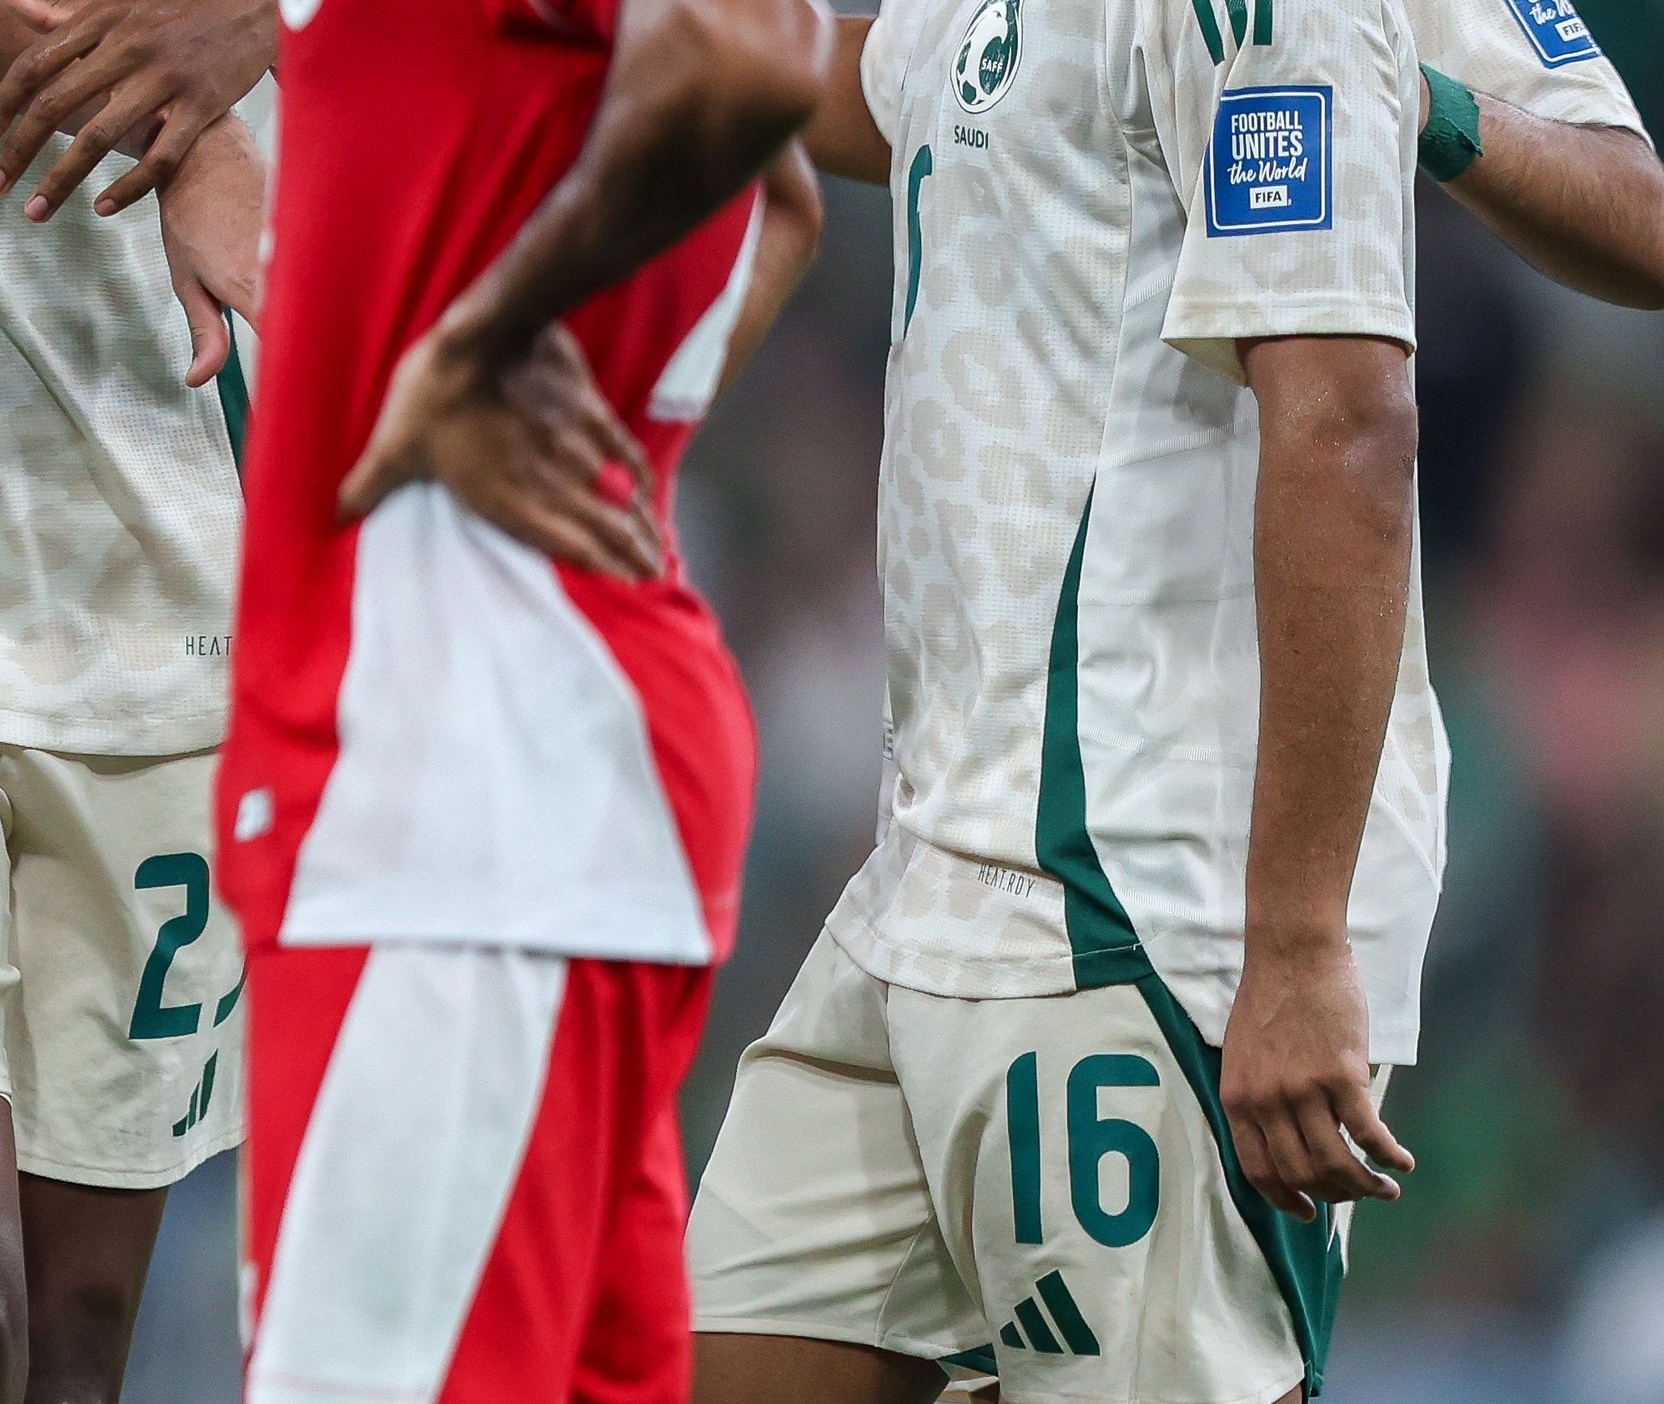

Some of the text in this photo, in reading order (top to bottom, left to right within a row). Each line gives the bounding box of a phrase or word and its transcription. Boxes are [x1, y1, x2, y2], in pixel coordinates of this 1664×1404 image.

[980, 58, 1005, 74] SAFF
[1231, 110, 1303, 133] FOOTBALL
[954, 124, 990, 150] SAUDI
[1231, 130, 1304, 161] UNITES
[1226, 156, 1308, 185] the World
[1255, 190, 1283, 204] FIFA
[978, 861, 1036, 899] HEAT.RDY
[128, 852, 250, 1039] 2
[1007, 1051, 1161, 1248] 16
